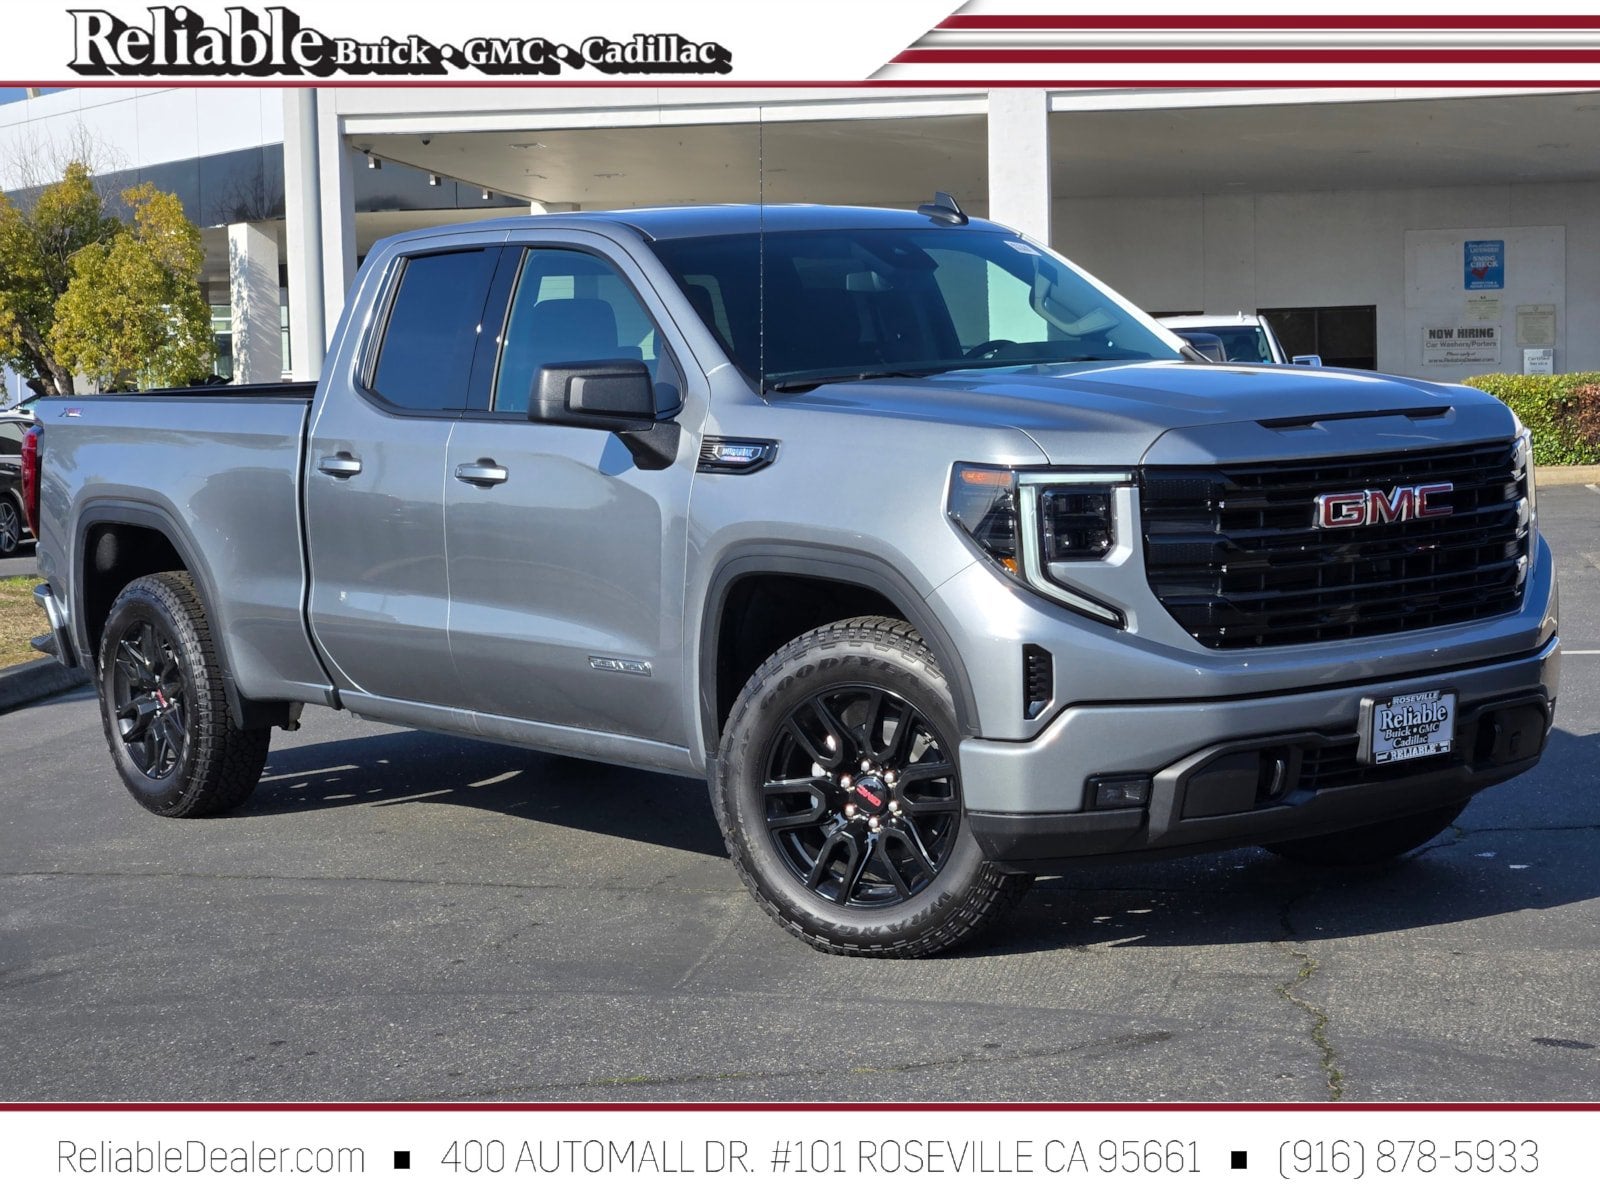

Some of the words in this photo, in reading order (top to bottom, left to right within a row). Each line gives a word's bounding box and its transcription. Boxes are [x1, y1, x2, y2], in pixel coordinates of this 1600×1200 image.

[1470, 260, 1499, 268] CHECK
[1428, 328, 1454, 339] NOW
[1457, 327, 1495, 339] HIRING
[1439, 340, 1497, 349] Washers/Porters
[1314, 482, 1454, 528] GMC
[1392, 691, 1439, 705] ROSEVILLE
[1380, 700, 1448, 731] Reliable
[1385, 727, 1411, 740] Buick
[1418, 721, 1440, 735] GMC
[1392, 735, 1428, 749] Cadillac
[1390, 744, 1437, 761] RELIABLE
